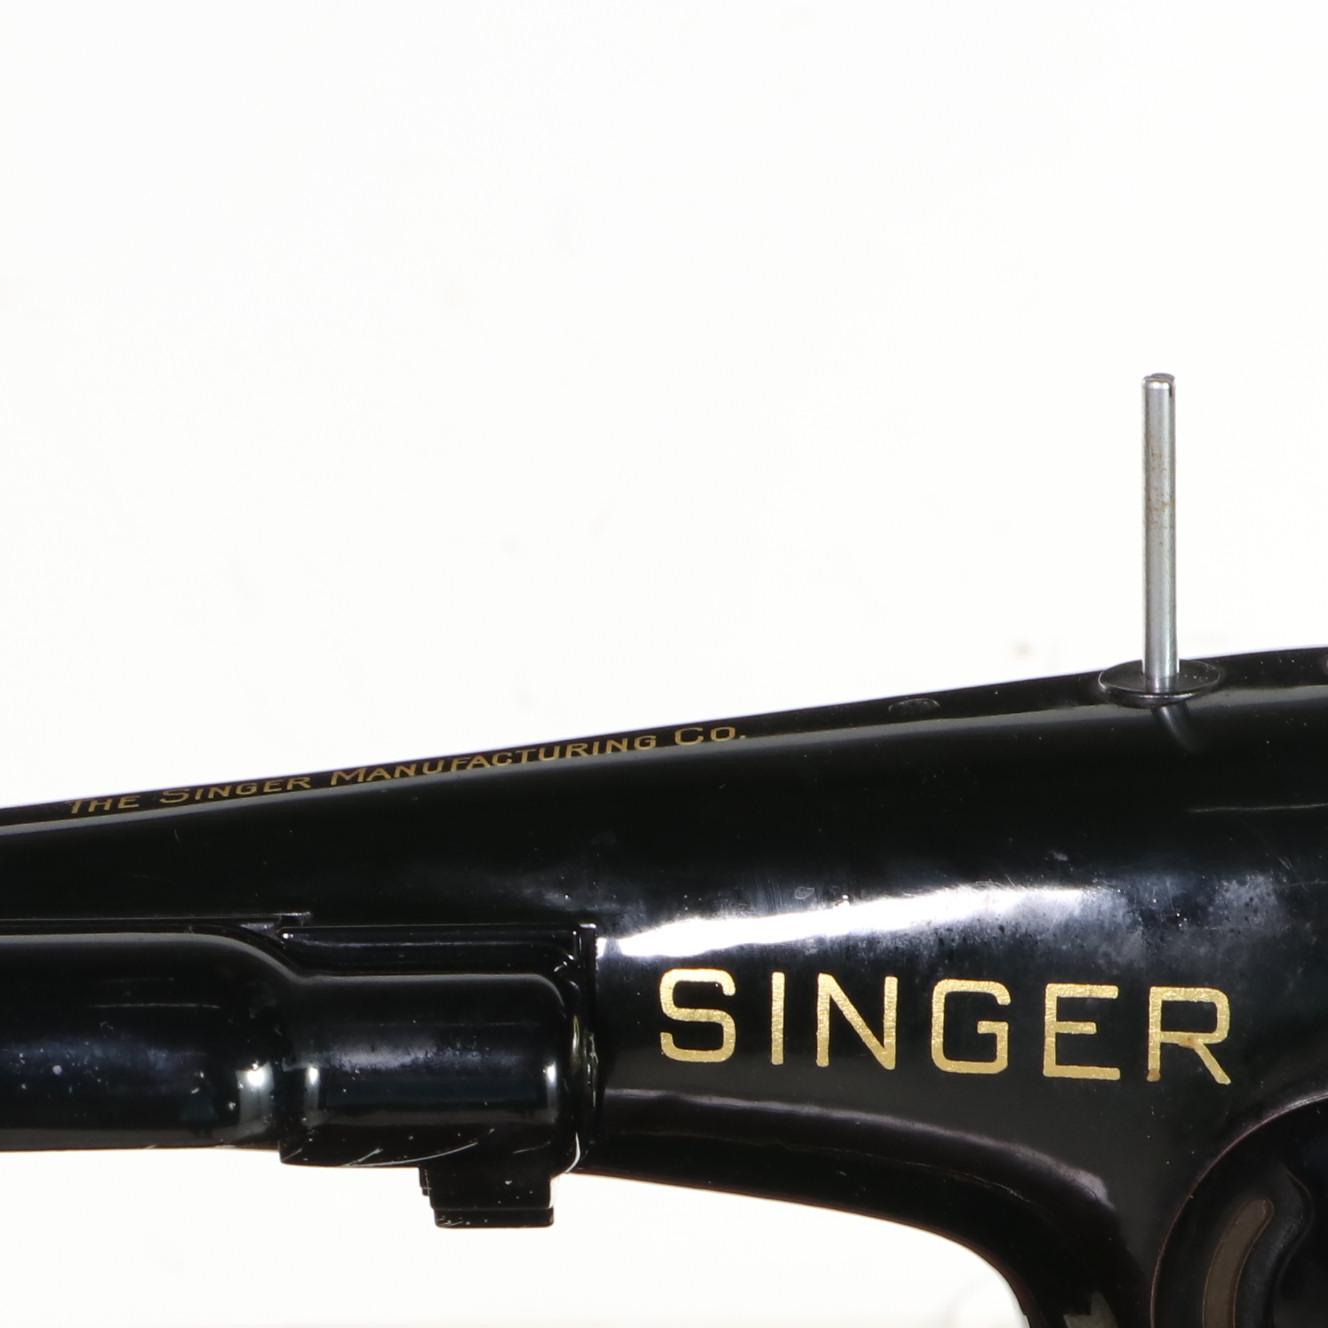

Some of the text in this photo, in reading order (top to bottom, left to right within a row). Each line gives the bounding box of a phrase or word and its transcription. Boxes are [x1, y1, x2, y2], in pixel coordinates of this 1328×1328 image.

[69, 794, 141, 815] THE
[159, 775, 312, 804] SINGER
[330, 734, 657, 787] MANUFACTURING
[659, 967, 1232, 1085] SINGER
